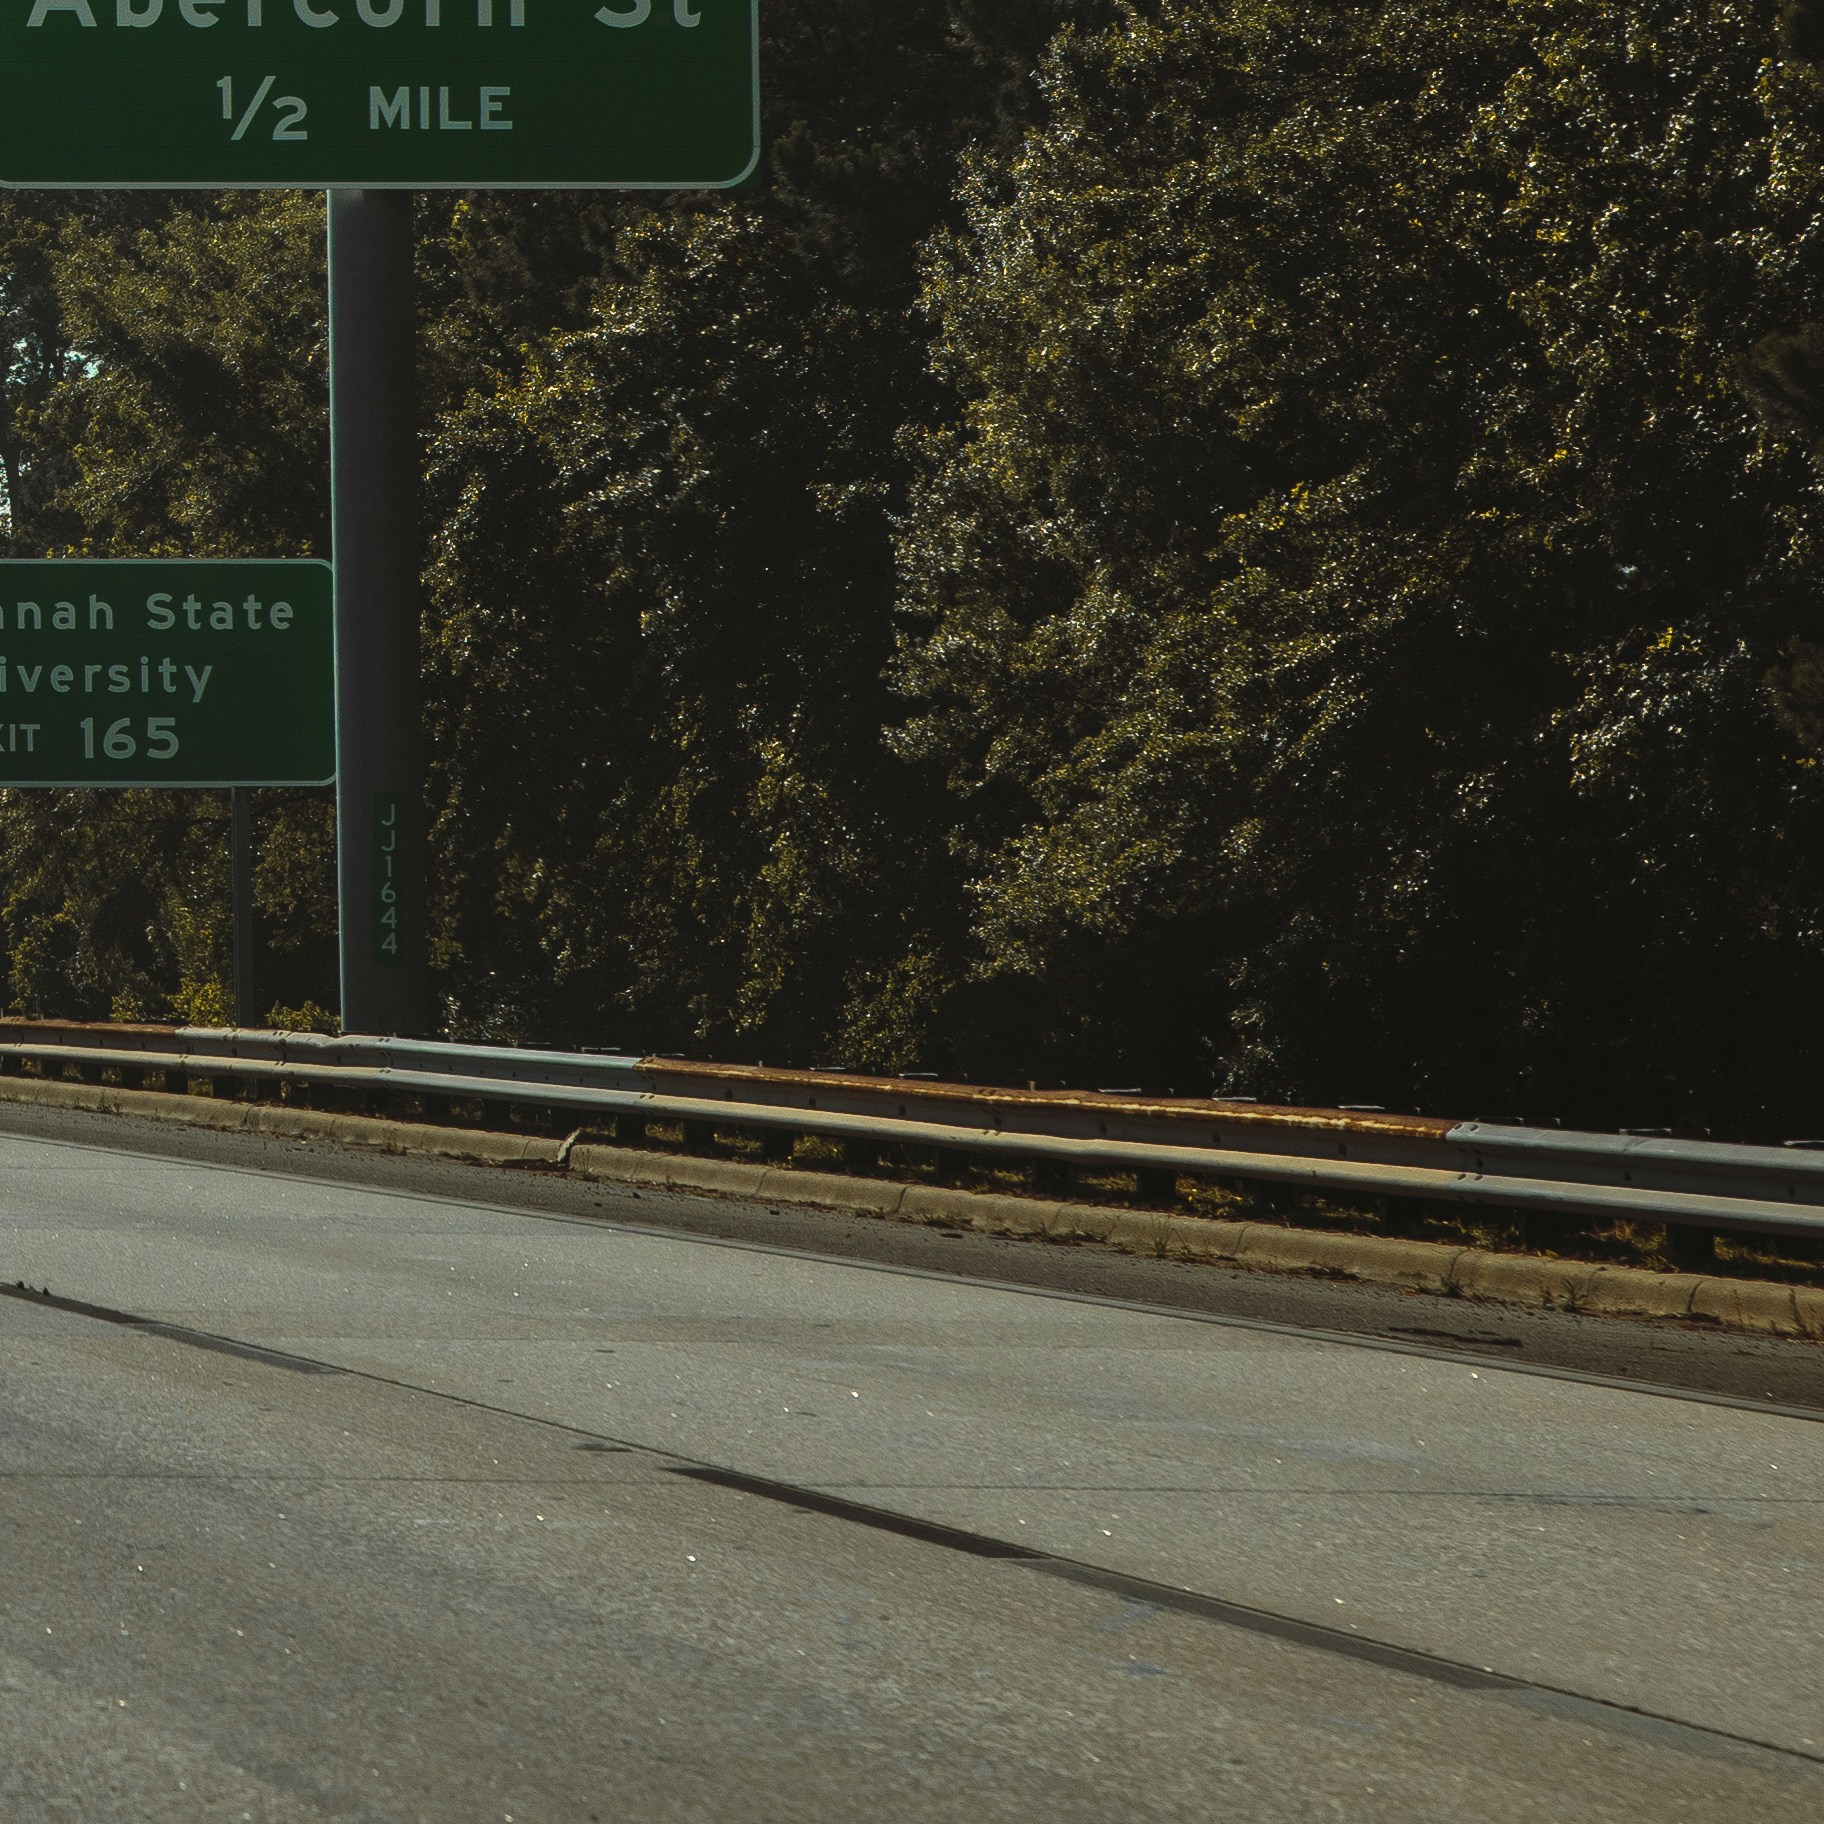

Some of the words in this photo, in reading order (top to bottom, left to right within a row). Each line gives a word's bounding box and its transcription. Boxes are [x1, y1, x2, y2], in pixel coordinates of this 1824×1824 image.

[369, 85, 513, 130] MILE
[146, 592, 294, 631] State
[80, 716, 180, 760] 165
[380, 803, 398, 955] JJ1644
